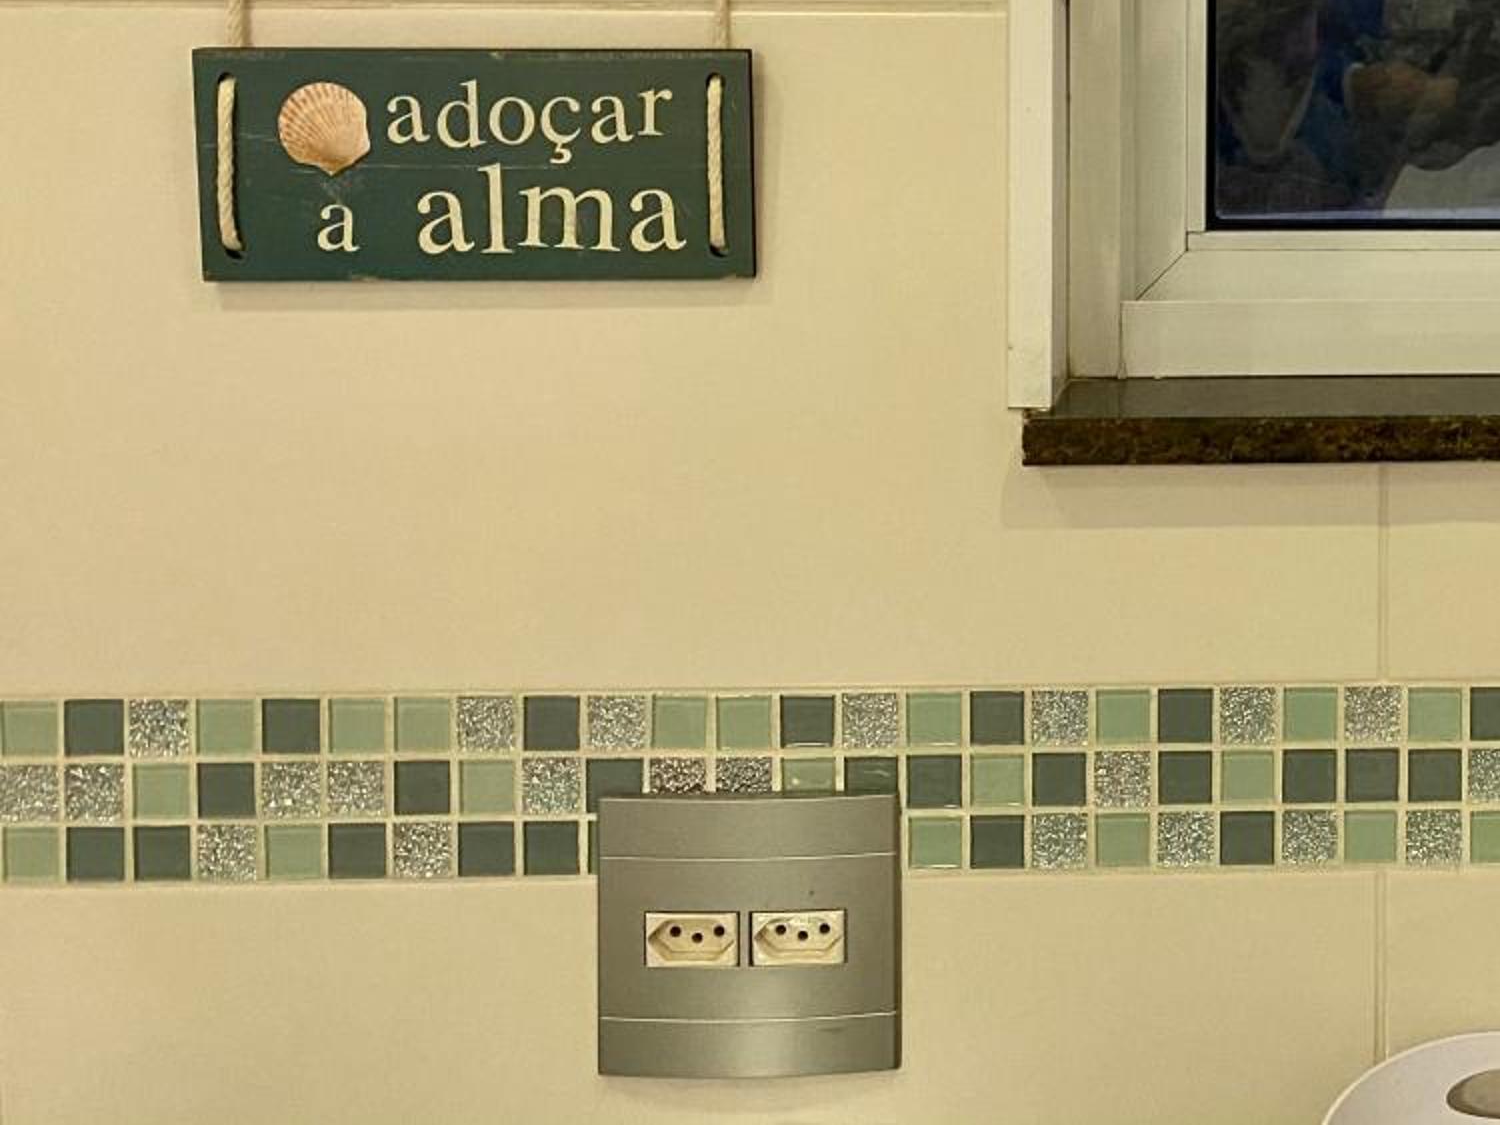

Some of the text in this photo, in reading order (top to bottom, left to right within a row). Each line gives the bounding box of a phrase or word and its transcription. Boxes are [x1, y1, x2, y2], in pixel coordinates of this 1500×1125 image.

[386, 79, 673, 164] adoçar
[317, 163, 687, 255] a alma
